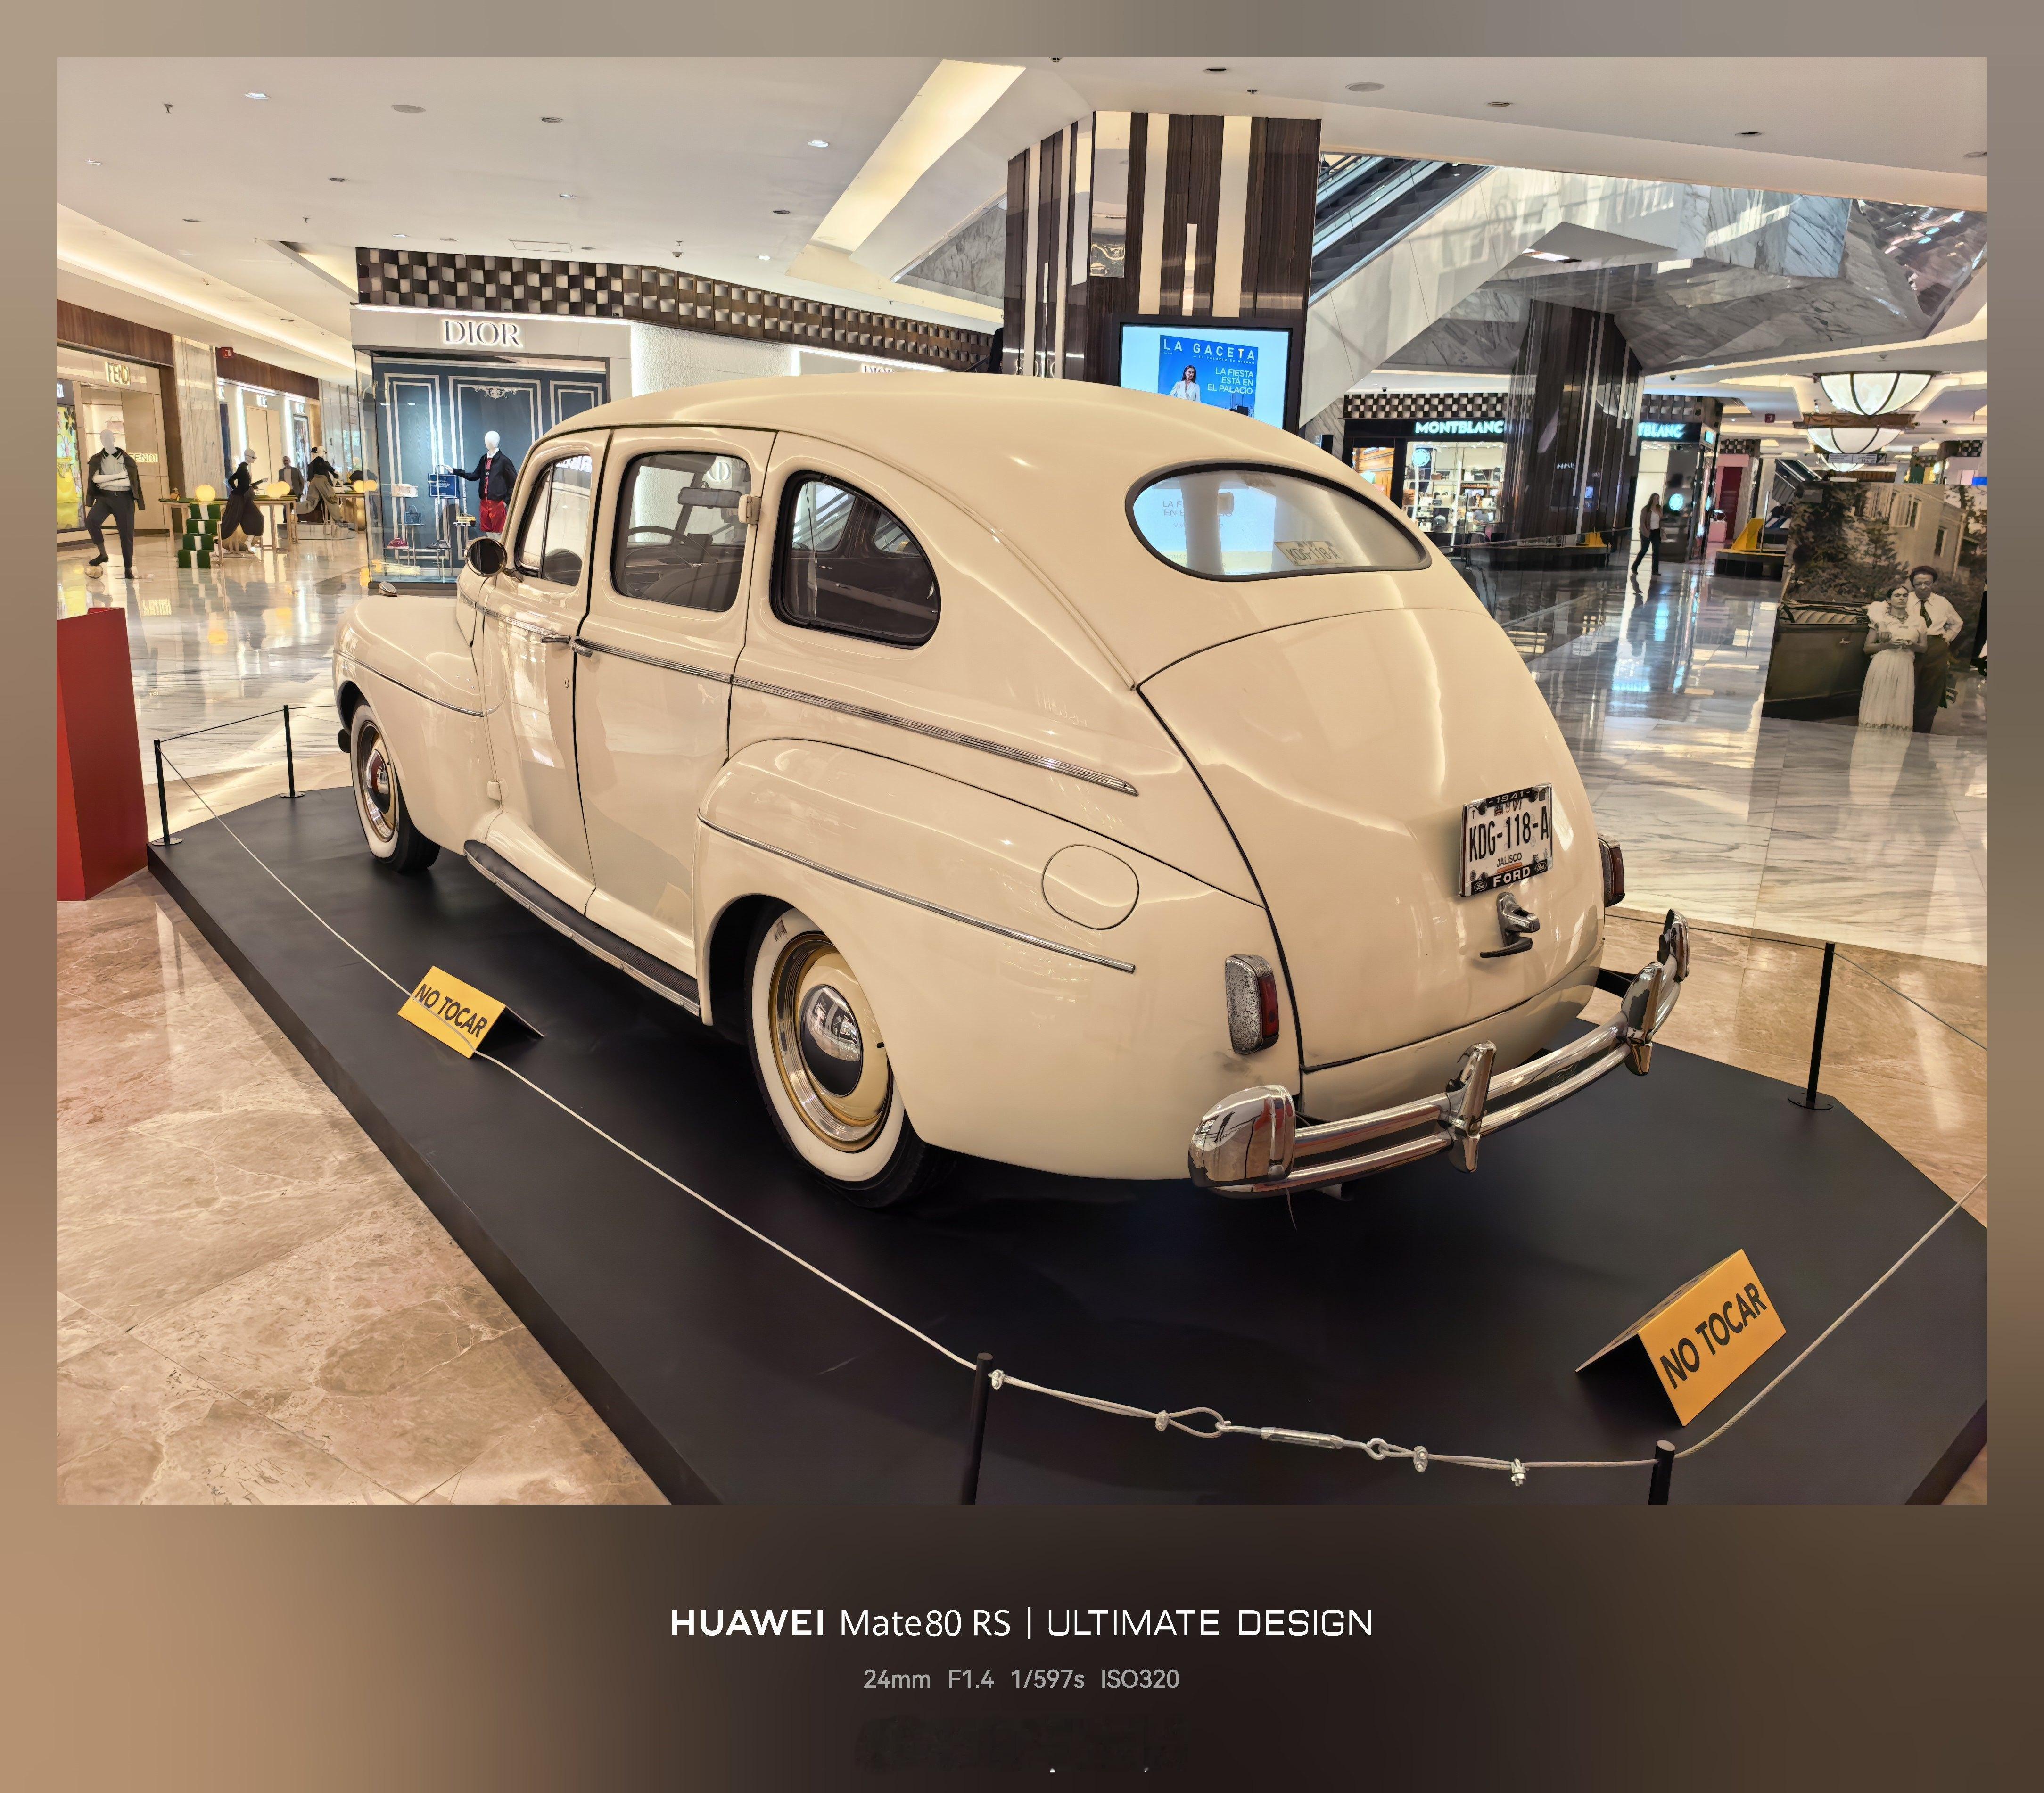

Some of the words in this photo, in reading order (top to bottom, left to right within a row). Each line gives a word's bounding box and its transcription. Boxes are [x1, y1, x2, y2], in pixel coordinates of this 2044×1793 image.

[444, 320, 522, 346] DIOR
[1163, 339, 1182, 352] LA
[1193, 343, 1255, 360] GACETA
[1215, 367, 1226, 376] LA
[1228, 369, 1254, 378] FIESTA
[1221, 375, 1241, 385] ESTÁ
[1243, 378, 1253, 387] EN
[1219, 384, 1253, 395] PALACIO
[1415, 420, 1504, 434] MONTBLANC
[1469, 806, 1549, 863] KDG-118-A
[1496, 852, 1522, 868] JALISCO
[1493, 866, 1531, 888] FORD
[414, 984, 440, 1009] NO
[437, 996, 488, 1038] TOCAR
[1659, 1338, 1700, 1390] NO
[1695, 1283, 1767, 1356] TOCAR
